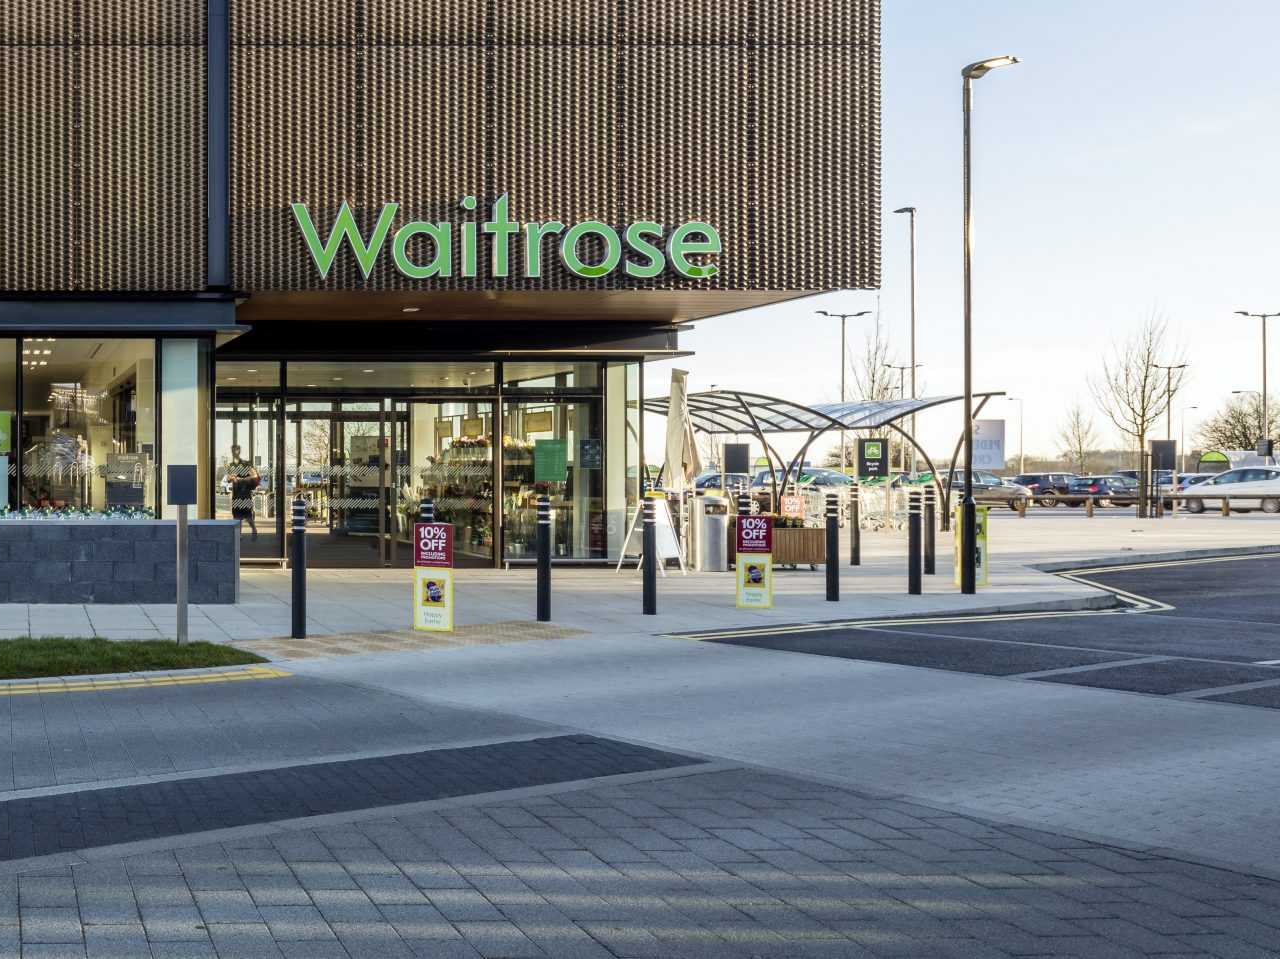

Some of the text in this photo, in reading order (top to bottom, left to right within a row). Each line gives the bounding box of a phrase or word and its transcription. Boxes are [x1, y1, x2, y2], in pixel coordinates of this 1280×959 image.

[290, 192, 722, 280] Waitrose
[741, 518, 768, 530] 10%
[419, 526, 447, 539] 10%
[742, 529, 767, 540] OFF
[420, 538, 446, 551] OFF
